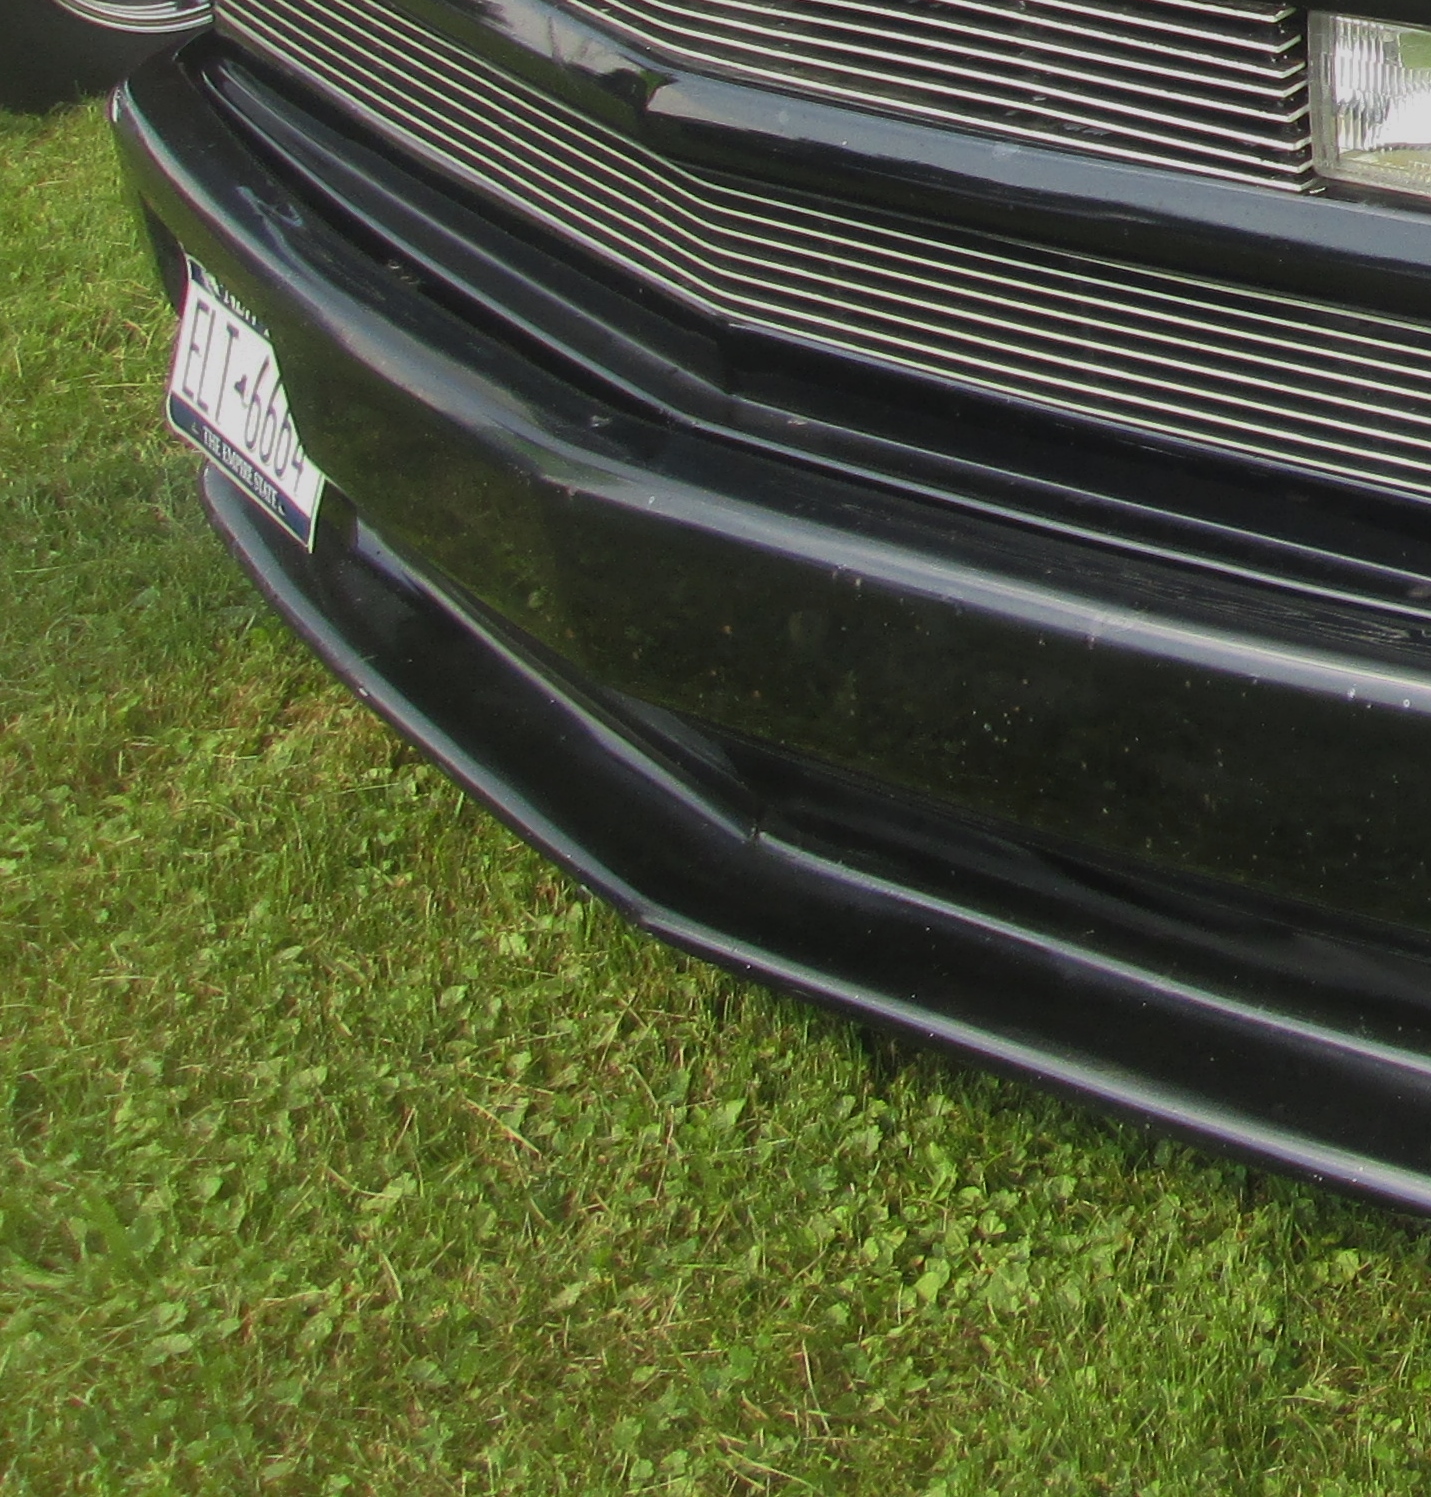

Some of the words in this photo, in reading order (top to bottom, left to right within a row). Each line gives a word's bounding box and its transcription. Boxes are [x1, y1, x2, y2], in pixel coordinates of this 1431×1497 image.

[181, 298, 240, 425] ELT
[202, 424, 221, 457] THE
[221, 441, 254, 487] EMPIRE
[253, 471, 279, 511] STATE
